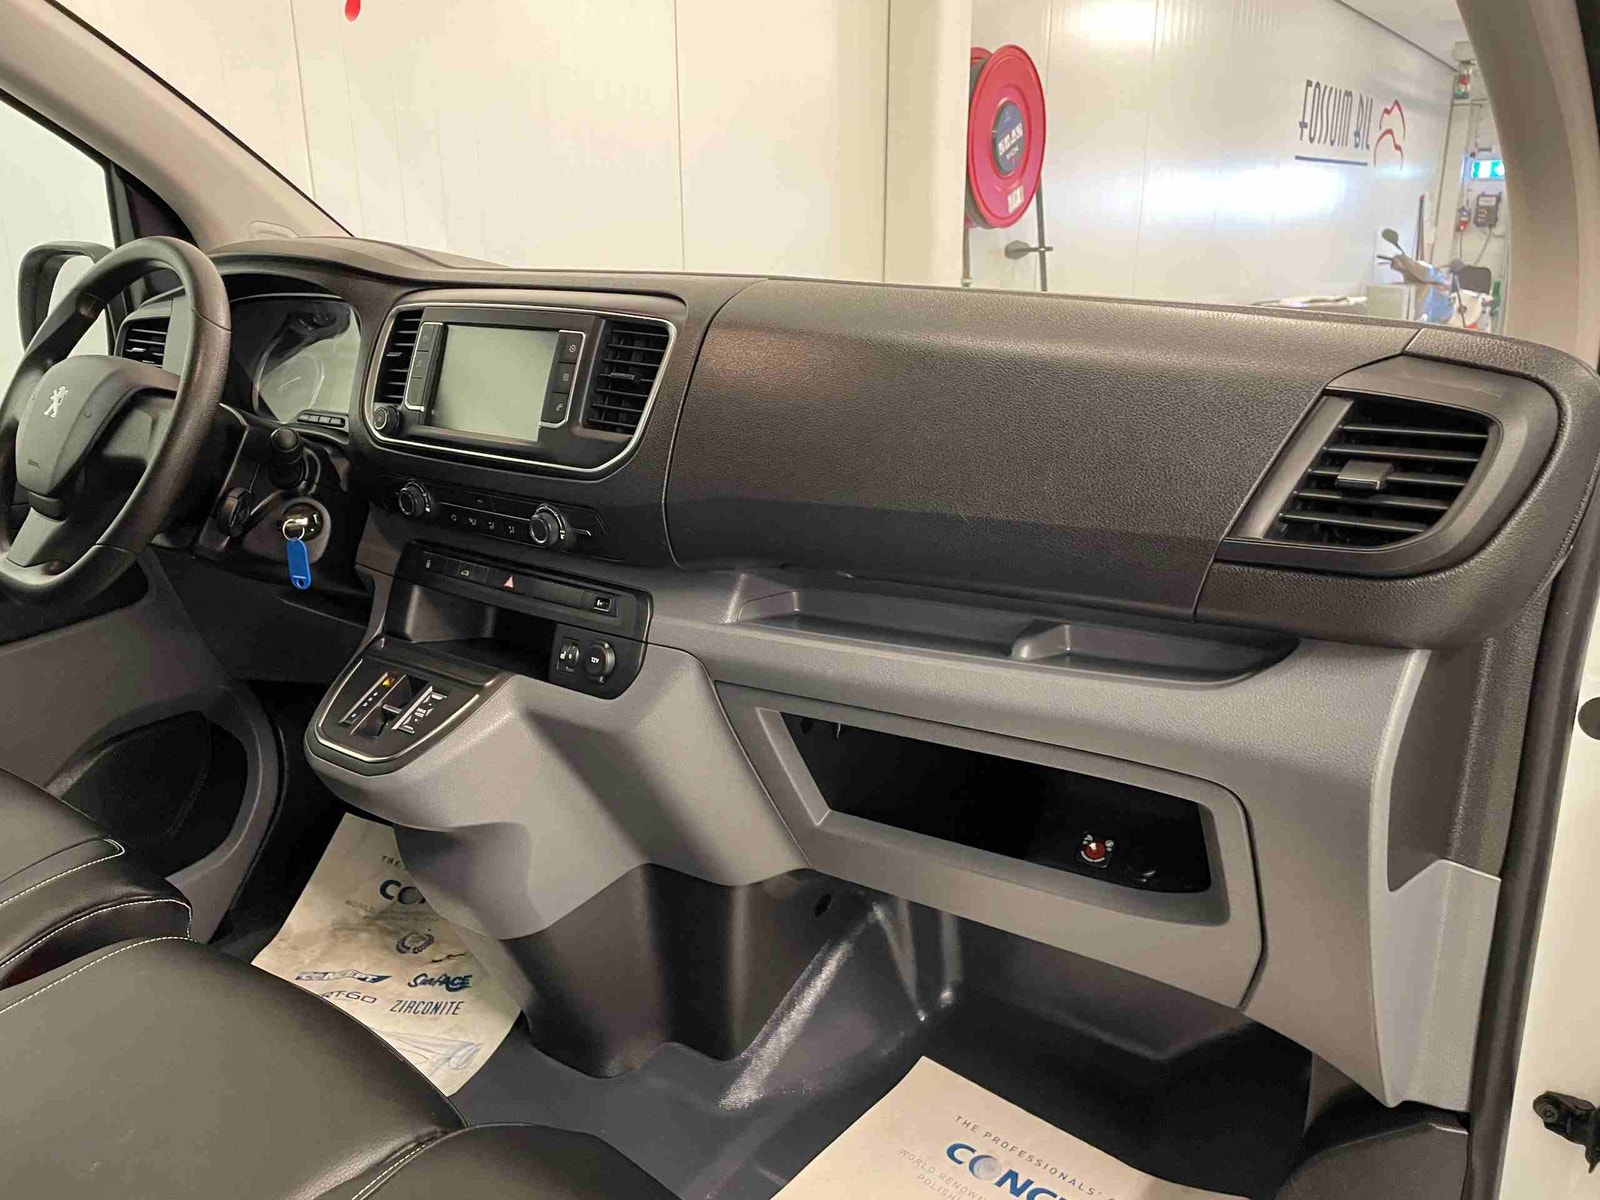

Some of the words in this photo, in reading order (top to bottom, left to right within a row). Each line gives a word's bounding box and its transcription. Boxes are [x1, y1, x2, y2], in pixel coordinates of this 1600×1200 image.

[1299, 79, 1353, 147] FOSSUM
[1354, 93, 1374, 150] BIL
[381, 855, 401, 868] THE
[380, 879, 426, 905] CO
[390, 1000, 465, 1016] ZIRCONITE
[954, 1115, 979, 1133] THE
[899, 1148, 936, 1174] WORLD
